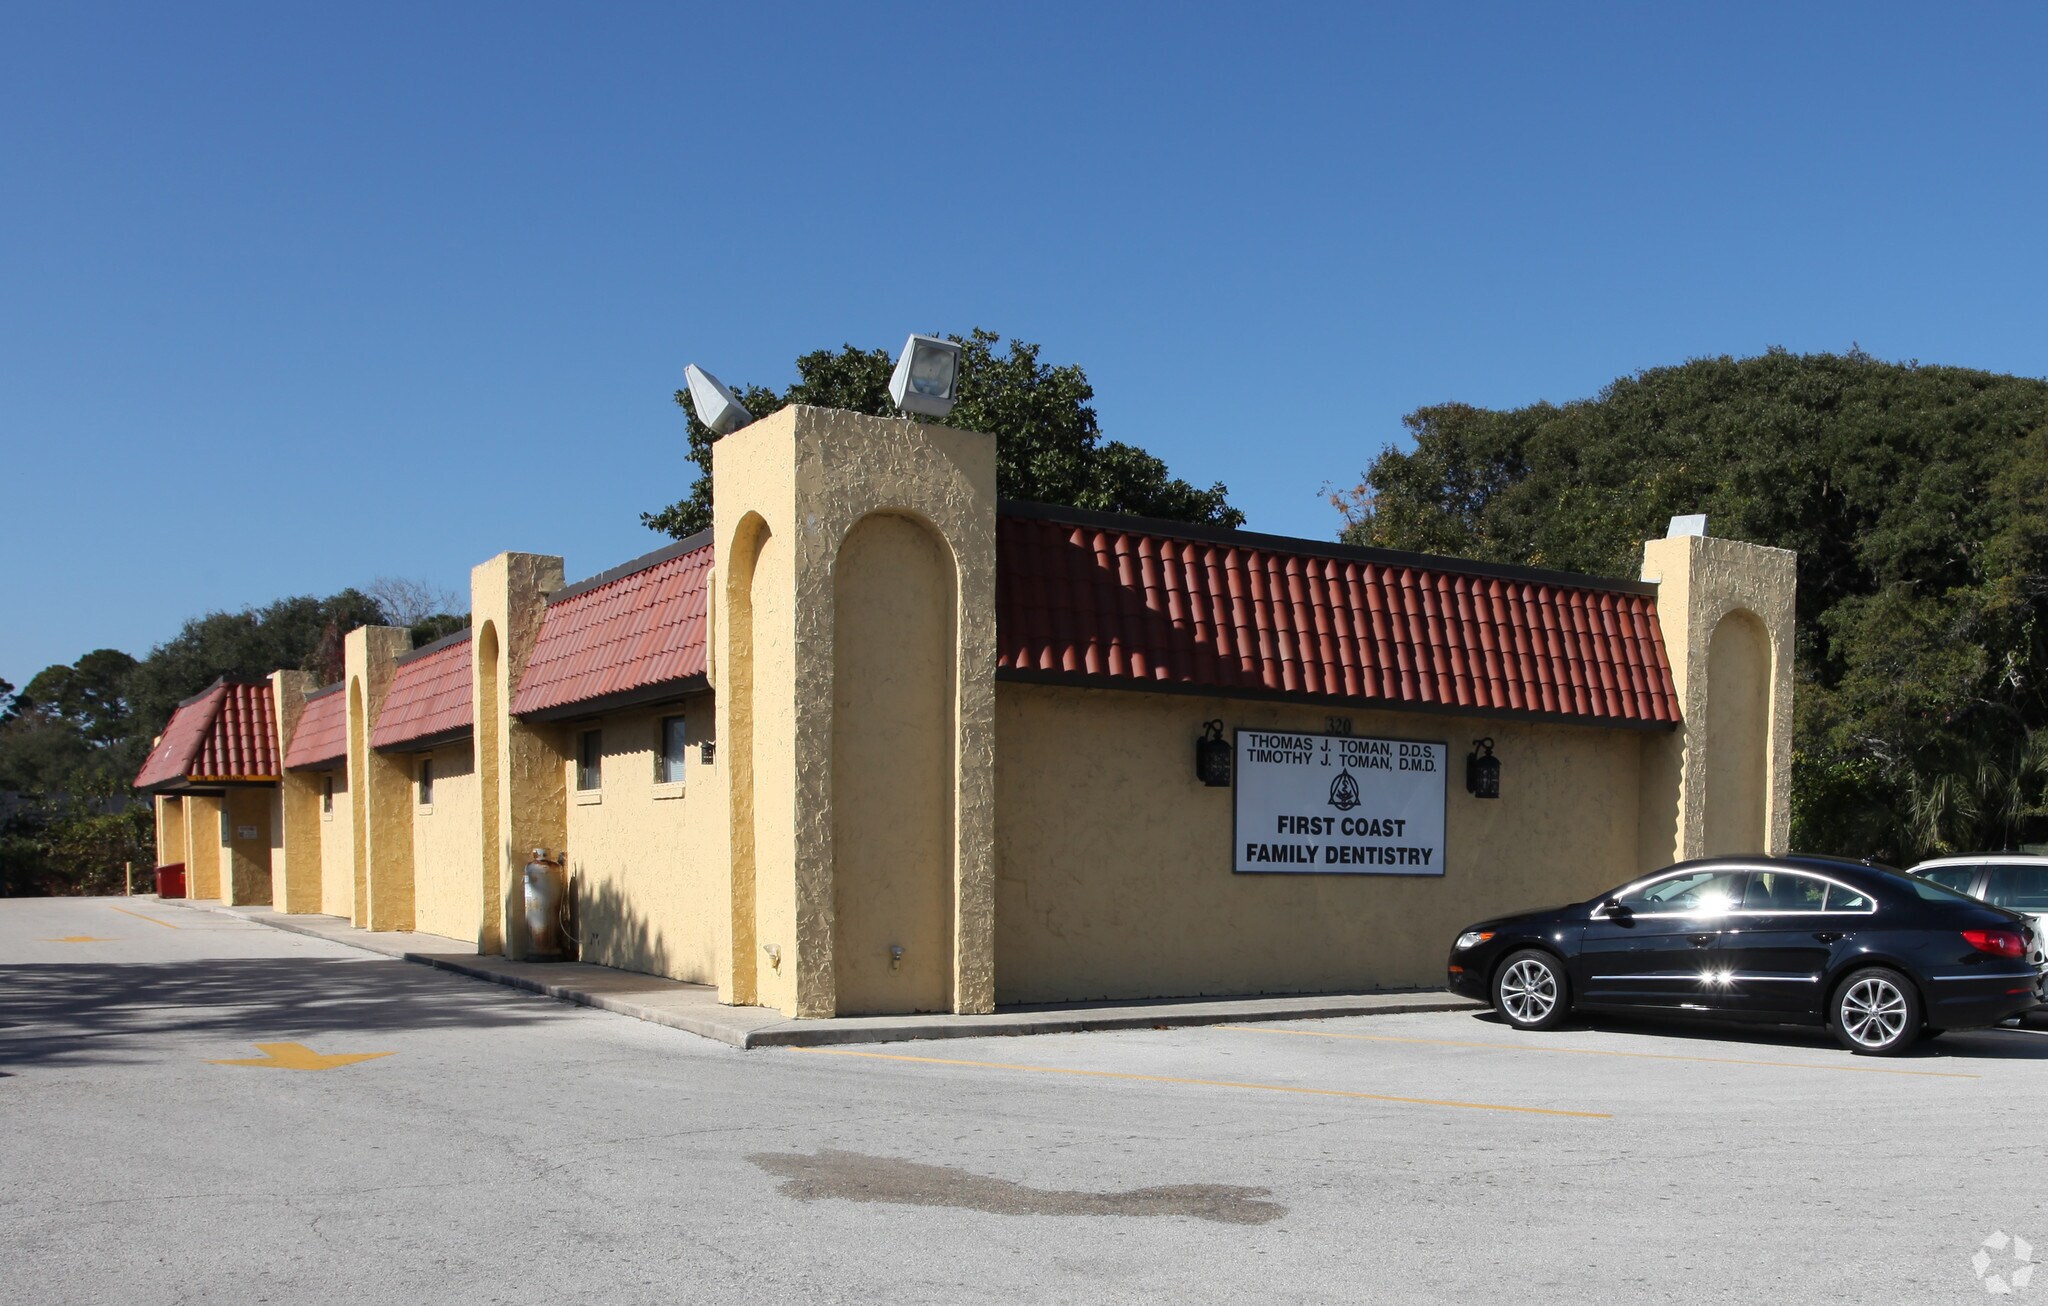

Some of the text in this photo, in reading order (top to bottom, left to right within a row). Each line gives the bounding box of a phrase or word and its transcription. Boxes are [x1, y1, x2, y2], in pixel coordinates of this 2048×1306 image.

[1327, 717, 1351, 735] 320
[1249, 734, 1435, 759] THOMAS J. TOMAN, D.D.S.
[1247, 748, 1436, 772] TIMOTHY J. TOMAN, D.M.D.
[1277, 815, 1406, 837] FIRST COAST
[1246, 843, 1433, 865] FAMILY DENTISTRY
